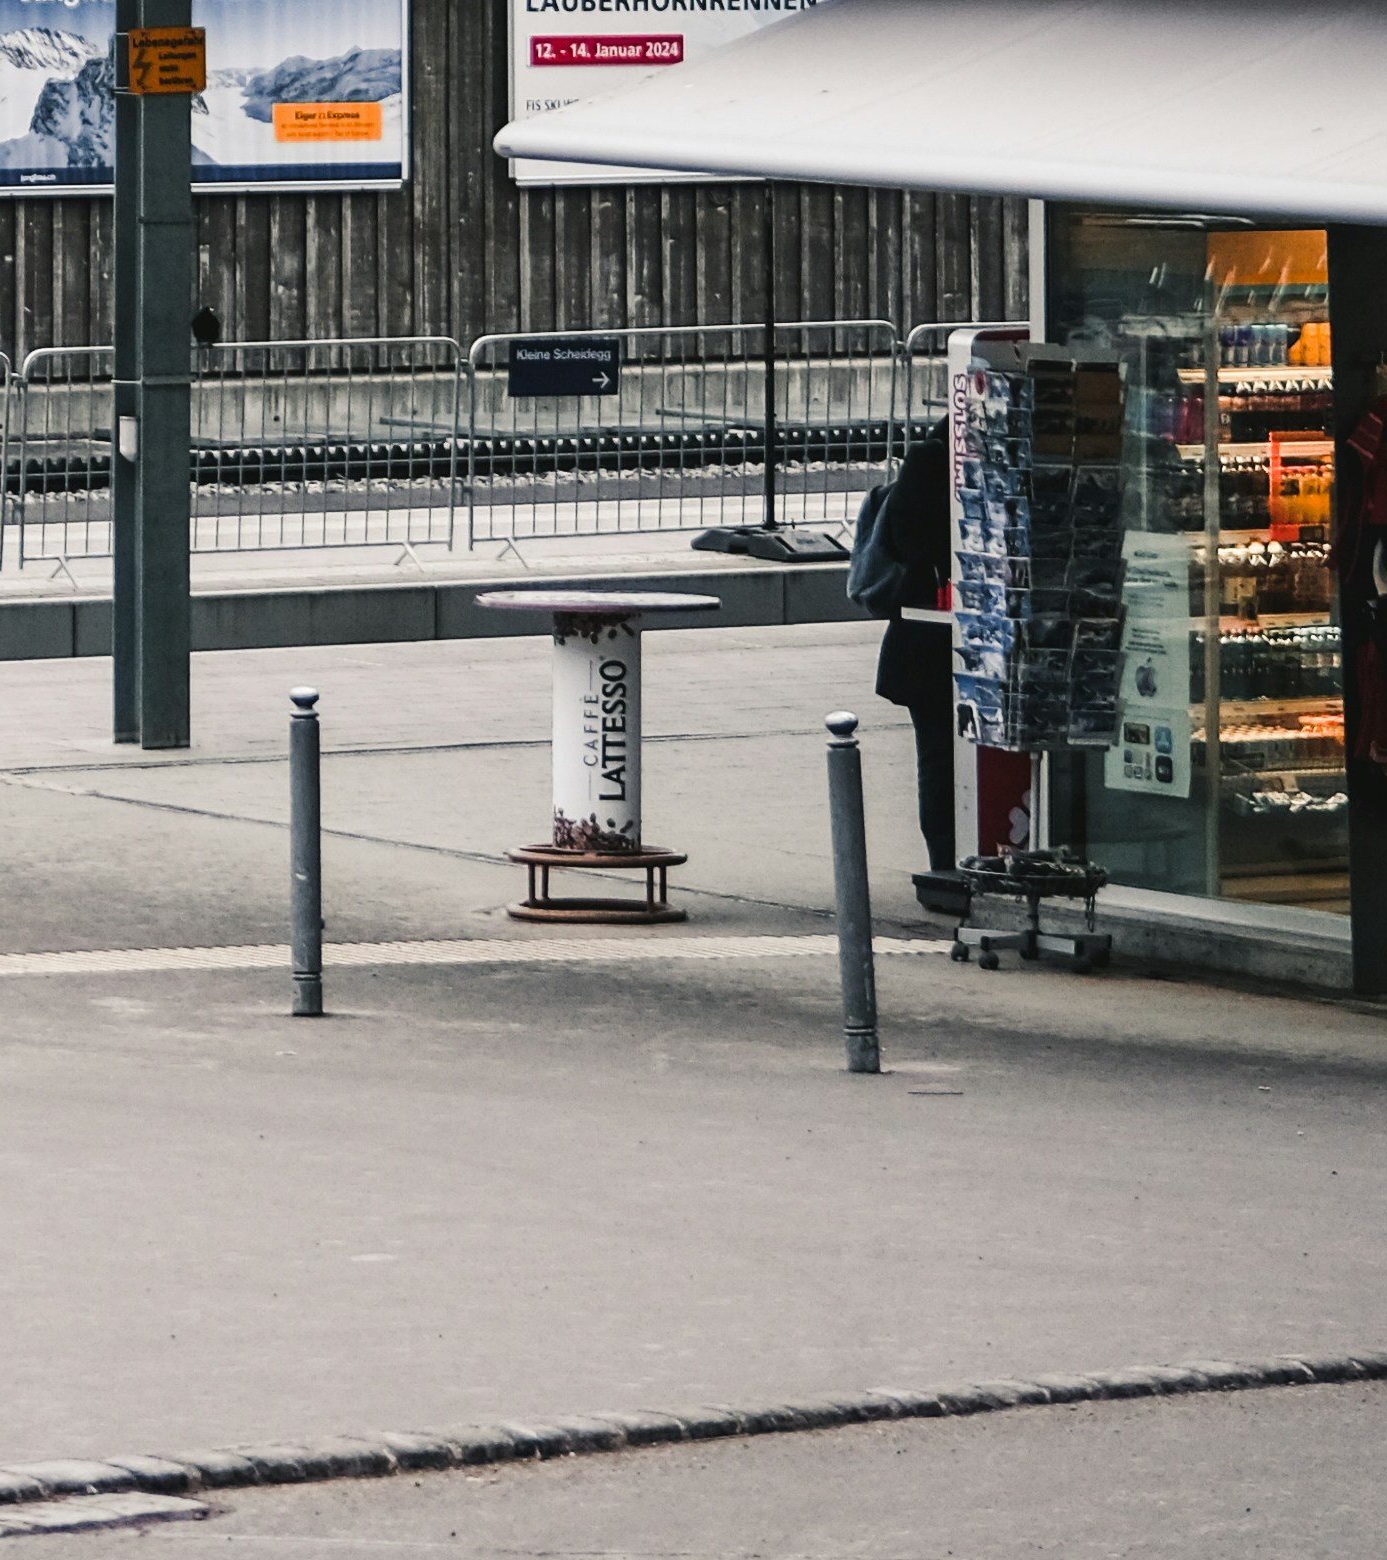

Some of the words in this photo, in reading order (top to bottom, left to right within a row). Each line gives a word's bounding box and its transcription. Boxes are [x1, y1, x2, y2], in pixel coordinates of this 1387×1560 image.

[535, 43, 556, 58] 12.
[570, 43, 591, 58] 14.
[595, 43, 642, 58] Januar
[645, 41, 679, 57] 2024
[516, 348, 550, 360] Kleine
[553, 348, 611, 361] Scheidegg
[599, 659, 626, 801] LATTESSO
